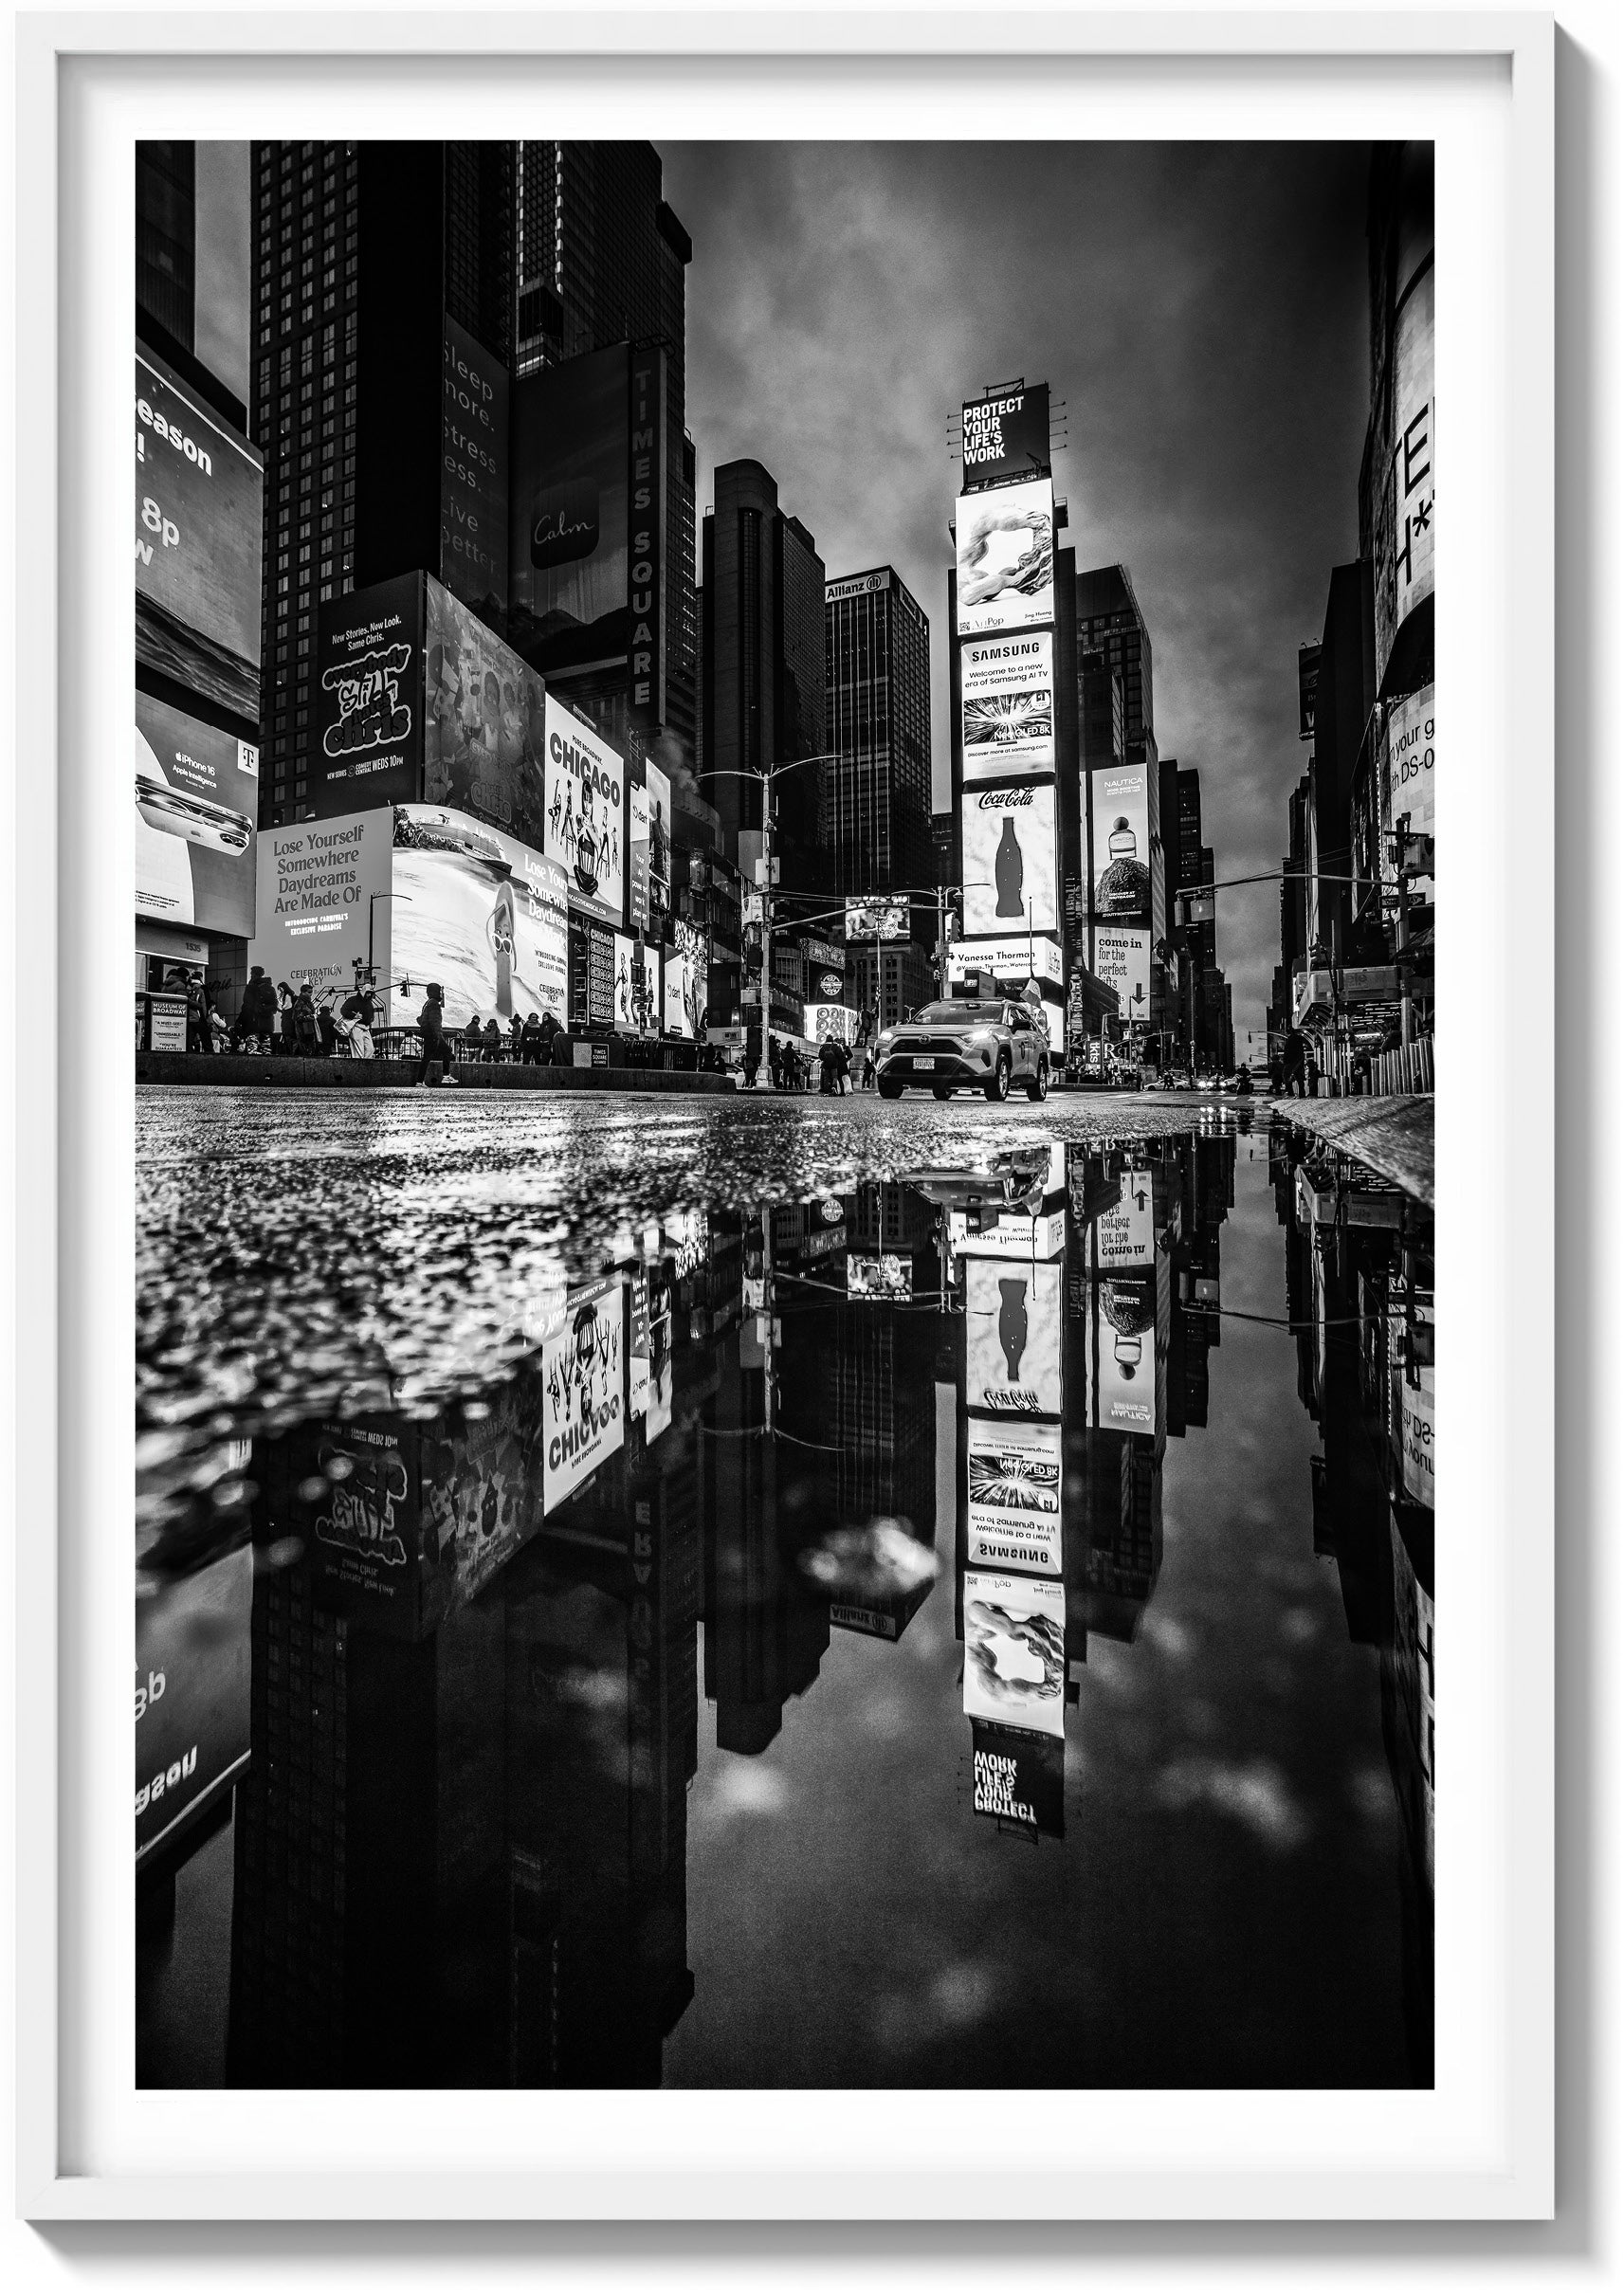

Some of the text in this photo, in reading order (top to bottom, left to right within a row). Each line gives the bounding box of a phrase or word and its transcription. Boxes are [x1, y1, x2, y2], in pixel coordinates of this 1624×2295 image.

[963, 395, 1024, 424] PROTECT
[963, 417, 1001, 436] YOUR
[136, 399, 211, 476] eason
[632, 369, 653, 510] TIMES
[963, 430, 1003, 451] LIFE'S
[963, 443, 1006, 465] WORK
[534, 511, 595, 545] Calm
[827, 582, 865, 600] Allianz
[632, 531, 653, 705] SQUARE
[332, 614, 402, 646] New Stories. New Look.
[348, 632, 385, 651] Same Chris.
[972, 642, 1040, 663] SAMSUNG
[965, 680, 978, 688] era
[979, 678, 988, 686] of
[990, 673, 1027, 685] Samsung
[969, 667, 1006, 679] Welcome
[1039, 724, 1050, 735] 8K
[572, 735, 582, 749] PURE
[1012, 744, 1049, 753] samsung.com
[1396, 725, 1420, 761] your
[182, 754, 215, 776] iPhone 16
[355, 761, 372, 772] COMEDY
[356, 766, 373, 776] CENTRAL
[372, 757, 390, 772] WEDS
[550, 732, 621, 808] CHICAGO
[173, 764, 189, 776] Apple
[189, 771, 217, 788] Intelligence
[327, 769, 347, 780] NEW SERIES
[1104, 777, 1143, 788] NAUTICA
[274, 825, 365, 856] Lose Yourself
[277, 848, 359, 874] Somewhere
[524, 853, 547, 880] Lose
[278, 869, 356, 895] Daydreams
[632, 880, 648, 894] poweed
[274, 885, 362, 914] Are Made Of
[284, 913, 349, 927] INTRODUCING CARNIVAL'S
[632, 907, 648, 920] planer
[290, 922, 342, 936] EXCLUSIVE PARADISE
[591, 929, 614, 947] CHICAGO
[1098, 938, 1142, 949] come in
[186, 942, 202, 953] 1535
[1098, 946, 1125, 961] for the
[958, 951, 1035, 962] Vanessa Thorman
[290, 965, 342, 979] CELEBRATION
[956, 961, 1038, 972] @Vanessa_Thorman_Watercoor
[1098, 963, 1128, 977] perfect
[308, 976, 324, 986] KEY
[1101, 976, 1118, 989] ifts
